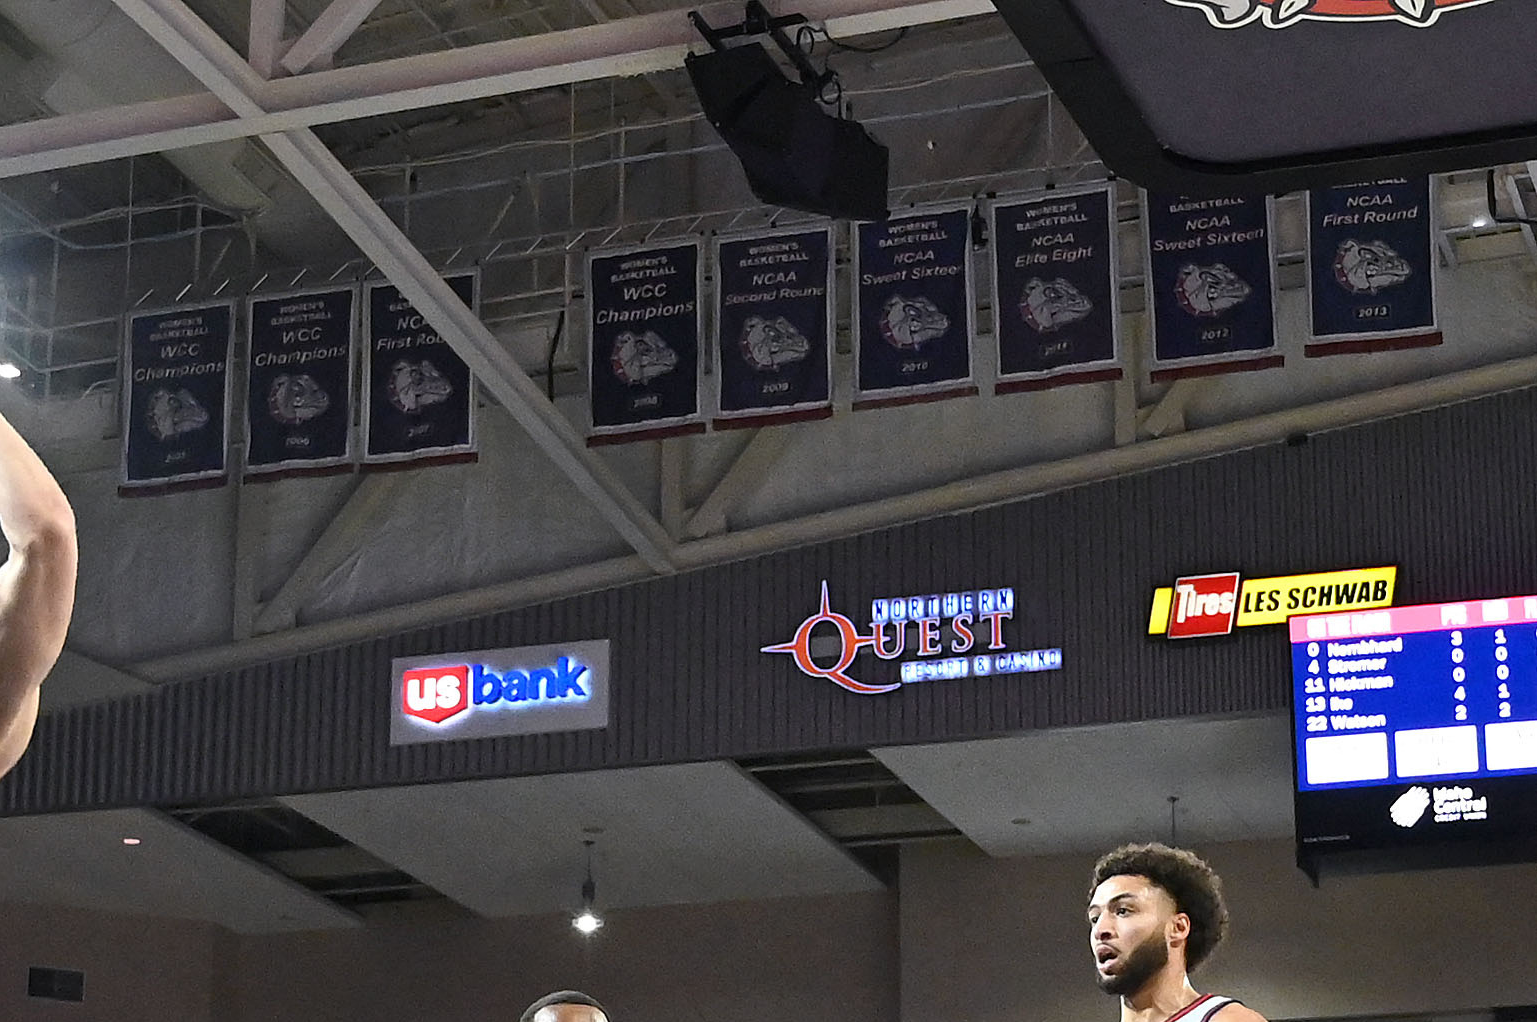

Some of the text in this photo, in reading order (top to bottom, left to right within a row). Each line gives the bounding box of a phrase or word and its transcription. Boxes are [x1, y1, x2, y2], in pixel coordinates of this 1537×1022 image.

[1346, 193, 1393, 208] NCAA
[1185, 214, 1231, 232] NCAA
[1322, 206, 1418, 228] First Round
[1031, 231, 1075, 247] NCAA
[1153, 228, 1265, 253] Sweet Sixteen
[893, 250, 935, 266] NCAA
[1014, 245, 1093, 268] Elite Eight
[752, 271, 797, 286] NCAA
[862, 269, 906, 287] Sweet
[623, 283, 668, 301] WCC
[725, 290, 775, 306] Second
[396, 316, 430, 331] NC
[596, 301, 694, 325] Champions
[281, 327, 323, 344] WCC
[377, 330, 447, 352] First Rou
[160, 343, 201, 358] WCC
[254, 345, 346, 368] Champions
[135, 362, 224, 383] Champions
[873, 588, 1012, 620] NORTHERN
[1243, 580, 1388, 613] LES SCHWAB
[778, 597, 1012, 693] QUEST
[1307, 641, 1320, 658] 0
[1495, 629, 1507, 644] 1
[901, 657, 968, 683] RESORT
[997, 649, 1061, 673] CASINO
[1308, 658, 1320, 675] 4
[1452, 648, 1464, 664] 0
[1495, 646, 1508, 662] 0
[407, 656, 588, 711] us bank
[1305, 677, 1325, 694] 11
[1452, 666, 1465, 682] 0
[1496, 664, 1509, 681] 0
[1305, 696, 1326, 713] 13
[1454, 685, 1466, 702] 4
[1497, 683, 1510, 699] 1
[1306, 715, 1328, 731] 22
[1454, 704, 1467, 720] 2
[1498, 702, 1511, 718] 2
